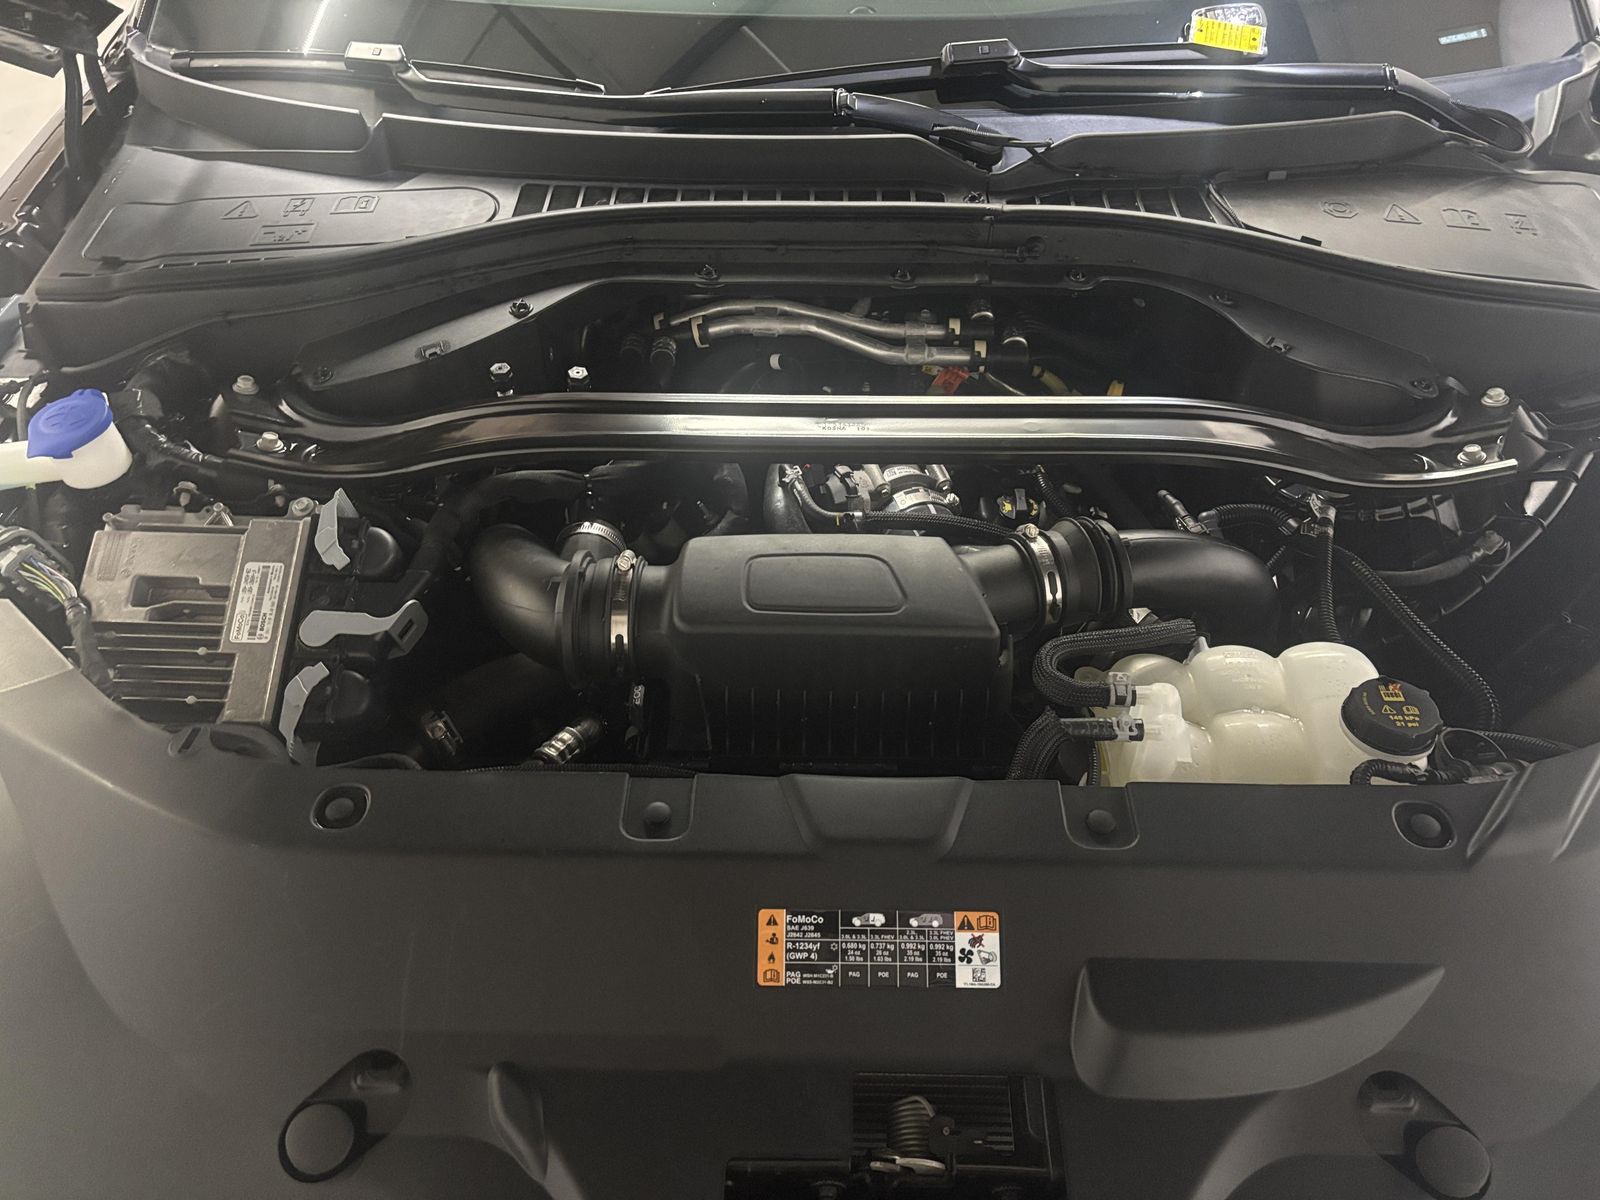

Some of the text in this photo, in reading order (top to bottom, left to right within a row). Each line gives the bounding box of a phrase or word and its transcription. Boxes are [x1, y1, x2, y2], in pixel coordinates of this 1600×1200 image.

[259, 612, 267, 632] BOSCH
[786, 914, 824, 924] FoMoCo
[786, 942, 820, 951] R-1234yf
[858, 942, 866, 950] kg
[886, 942, 894, 951] kg
[917, 942, 925, 951] kg
[946, 944, 954, 952] kg
[786, 952, 818, 961] (GWP 4)
